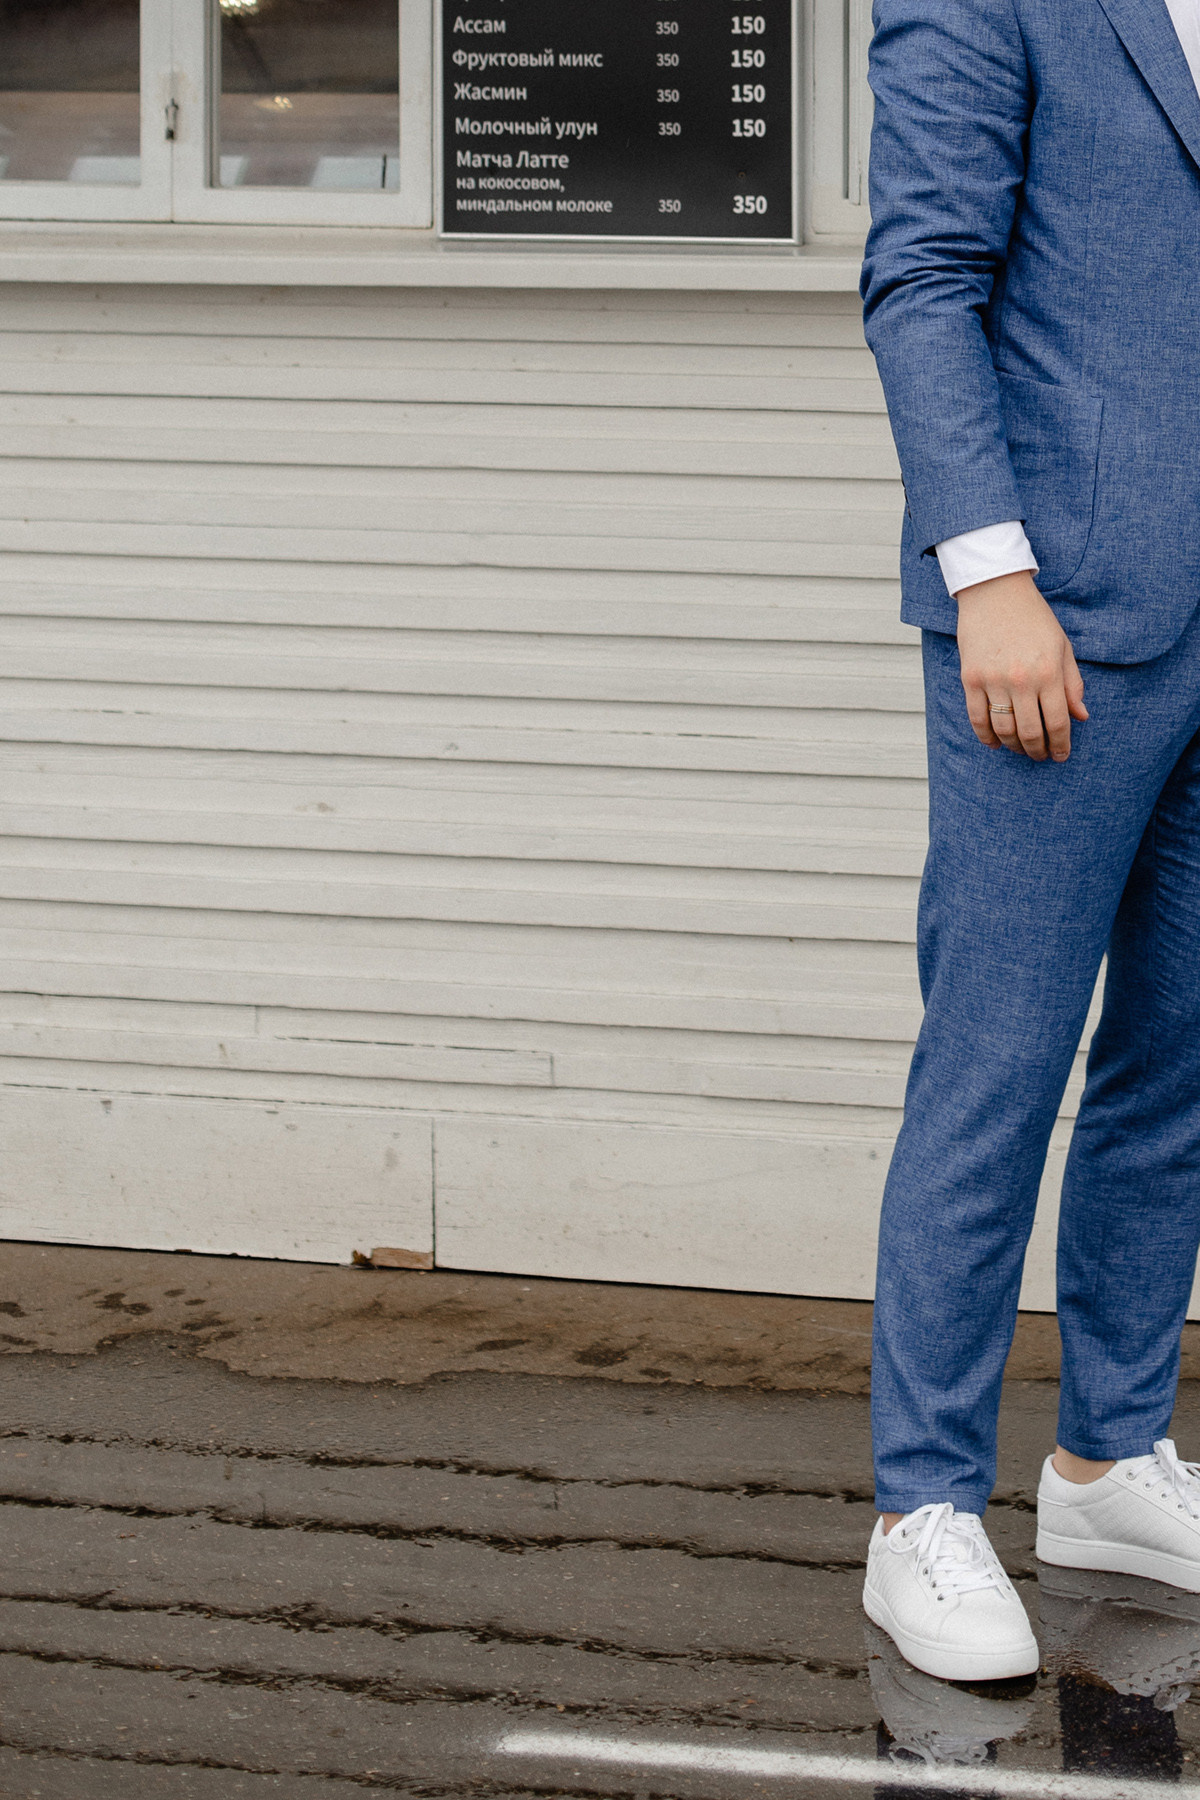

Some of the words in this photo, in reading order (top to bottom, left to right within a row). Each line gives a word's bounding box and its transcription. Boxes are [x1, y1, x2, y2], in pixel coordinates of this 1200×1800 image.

[453, 16, 506, 33] Ассам
[656, 22, 678, 34] 350
[732, 16, 765, 34] 150
[453, 49, 554, 70] Фруктовый
[559, 54, 603, 67] микс
[657, 53, 679, 66] 350
[731, 50, 765, 67] 150
[454, 83, 527, 100] Жасмин
[657, 89, 679, 102] 350
[732, 84, 765, 102] 150
[456, 117, 551, 135] Молочный
[555, 122, 597, 139] улун
[659, 122, 681, 135] 350
[733, 119, 766, 137] 150
[457, 150, 512, 168] Матча
[516, 151, 569, 168] Латте
[457, 178, 475, 189] на
[479, 178, 564, 192] кокосовом,
[457, 199, 552, 214] миндальном
[556, 200, 612, 212] молоке
[659, 200, 681, 212] 350
[733, 195, 767, 214] 350
